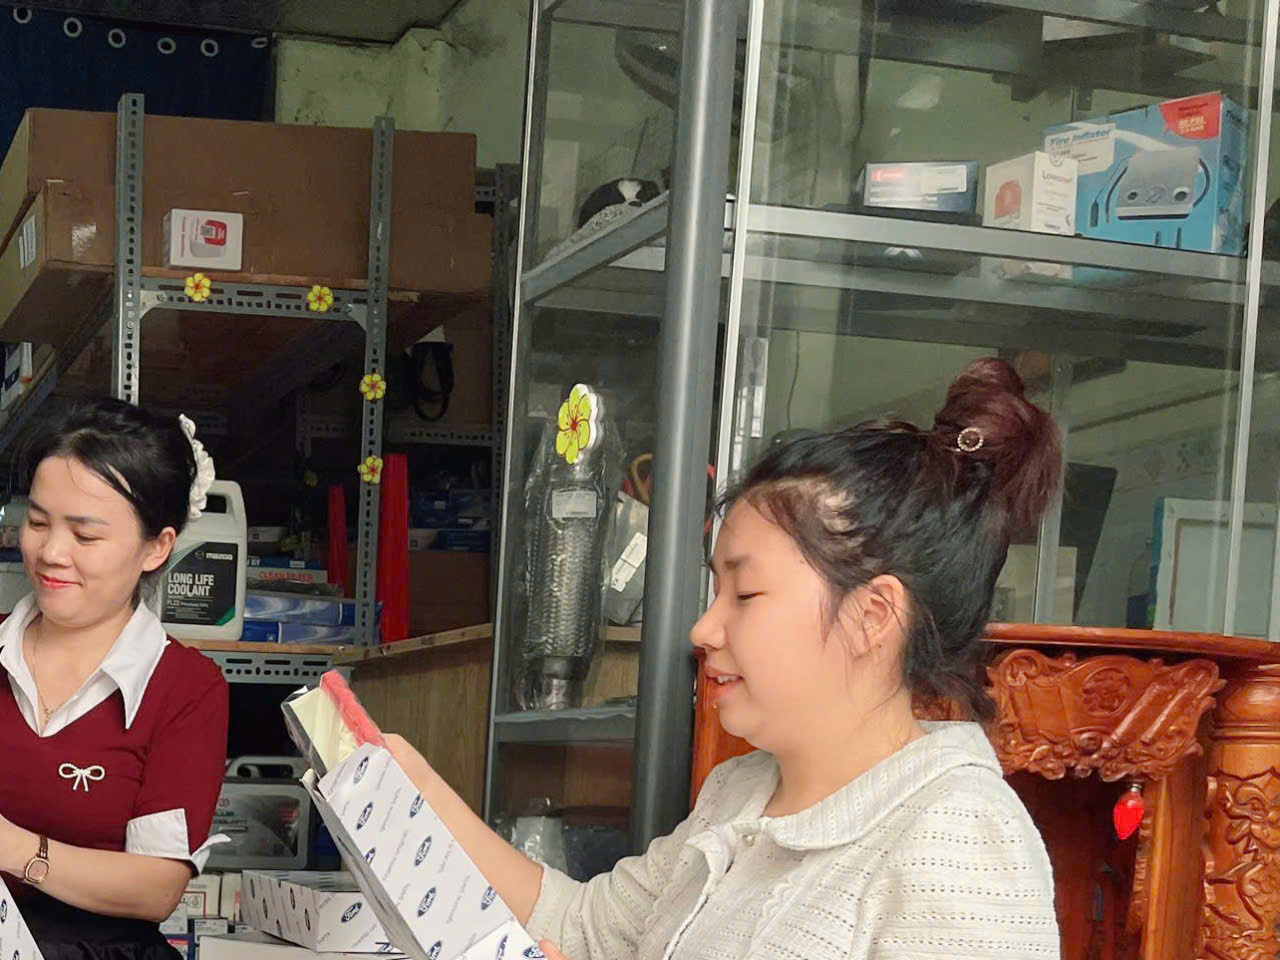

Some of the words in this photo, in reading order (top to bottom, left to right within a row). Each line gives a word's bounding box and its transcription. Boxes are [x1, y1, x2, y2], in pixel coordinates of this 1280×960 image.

[168, 572, 193, 584] LONG
[195, 573, 214, 586] LIFE
[168, 583, 211, 597] COOLANT
[418, 888, 435, 916] Ford
